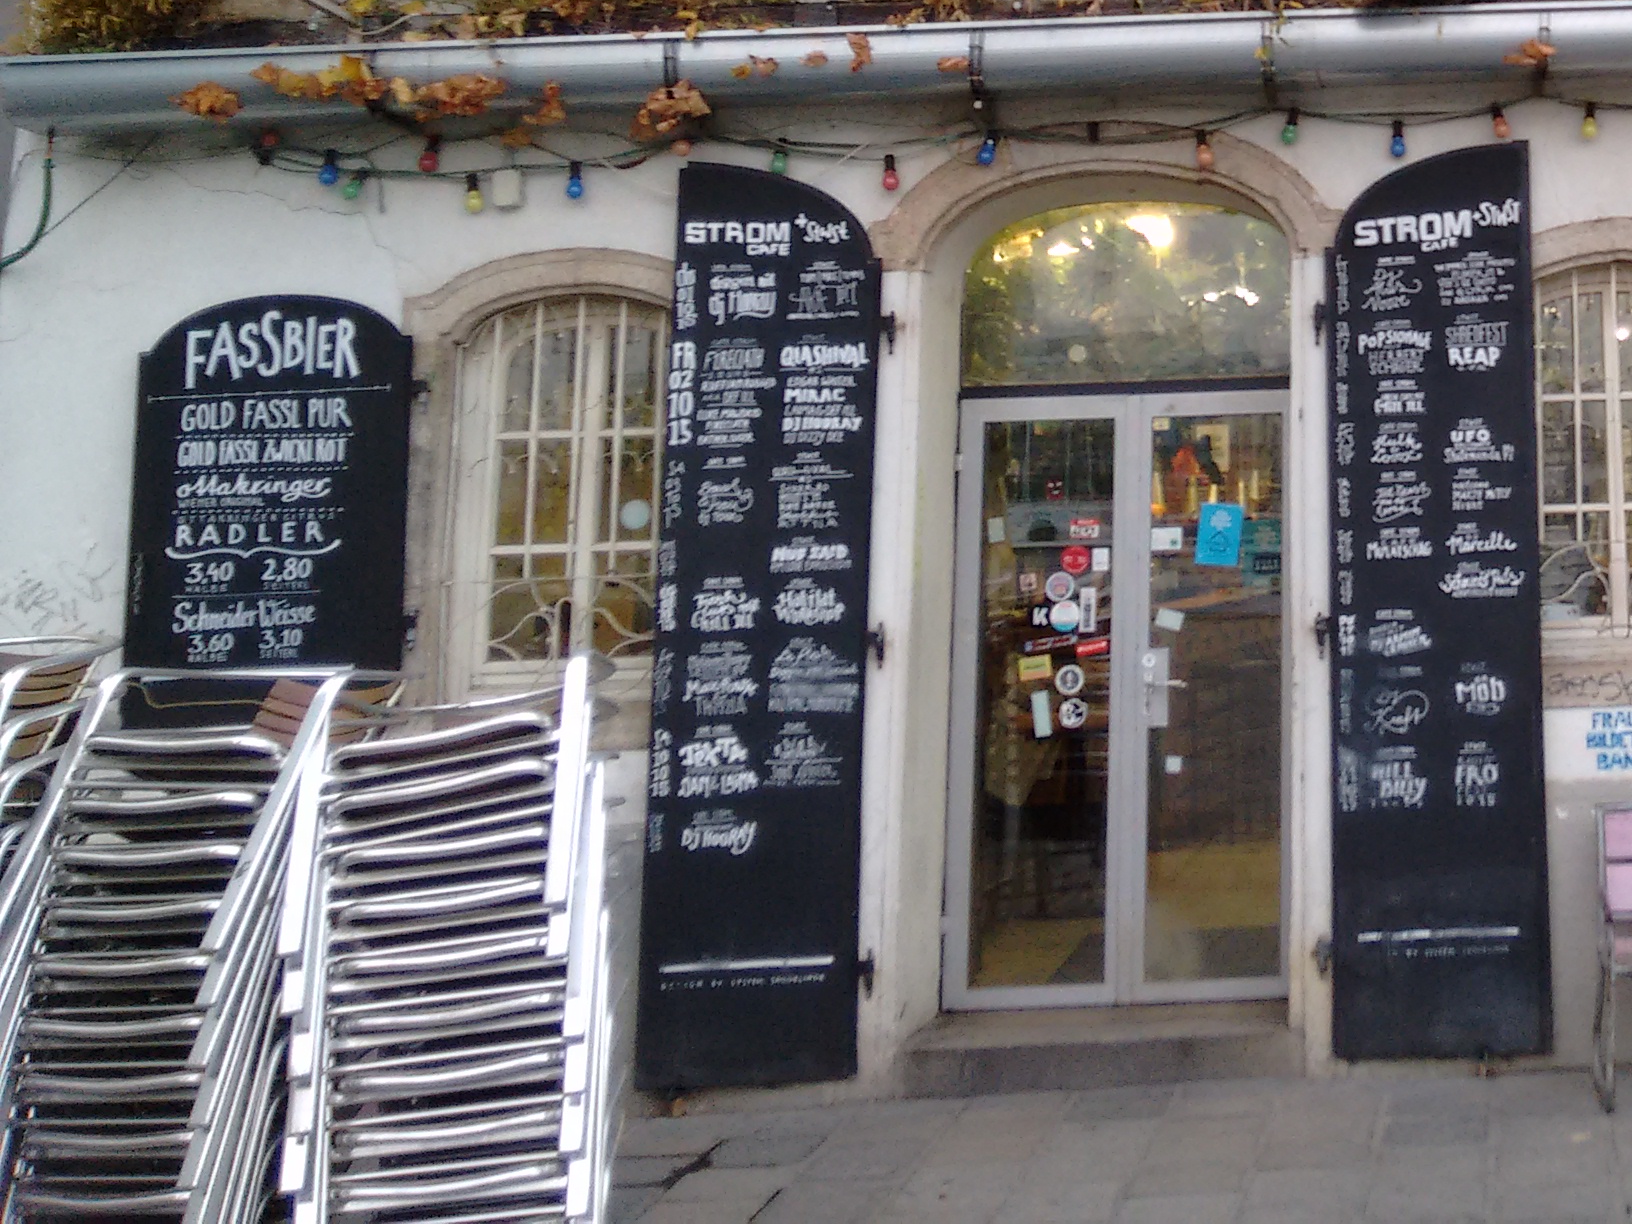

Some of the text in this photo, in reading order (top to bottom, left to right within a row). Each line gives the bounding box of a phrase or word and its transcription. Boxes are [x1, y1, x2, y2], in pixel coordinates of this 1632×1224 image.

[684, 222, 791, 244] STROM
[1353, 209, 1473, 247] STROM
[747, 243, 791, 256] CAFE
[1420, 236, 1459, 252] CAFE
[184, 310, 361, 389] FASSBIER
[181, 397, 353, 432] GOLD FASSL PUR
[668, 391, 695, 419] 10
[668, 418, 693, 446] 15
[1450, 429, 1491, 443] UFO
[177, 440, 216, 467] GOLD
[219, 438, 259, 465] FASSL
[314, 437, 348, 463] ROT
[175, 521, 324, 548] RADLER
